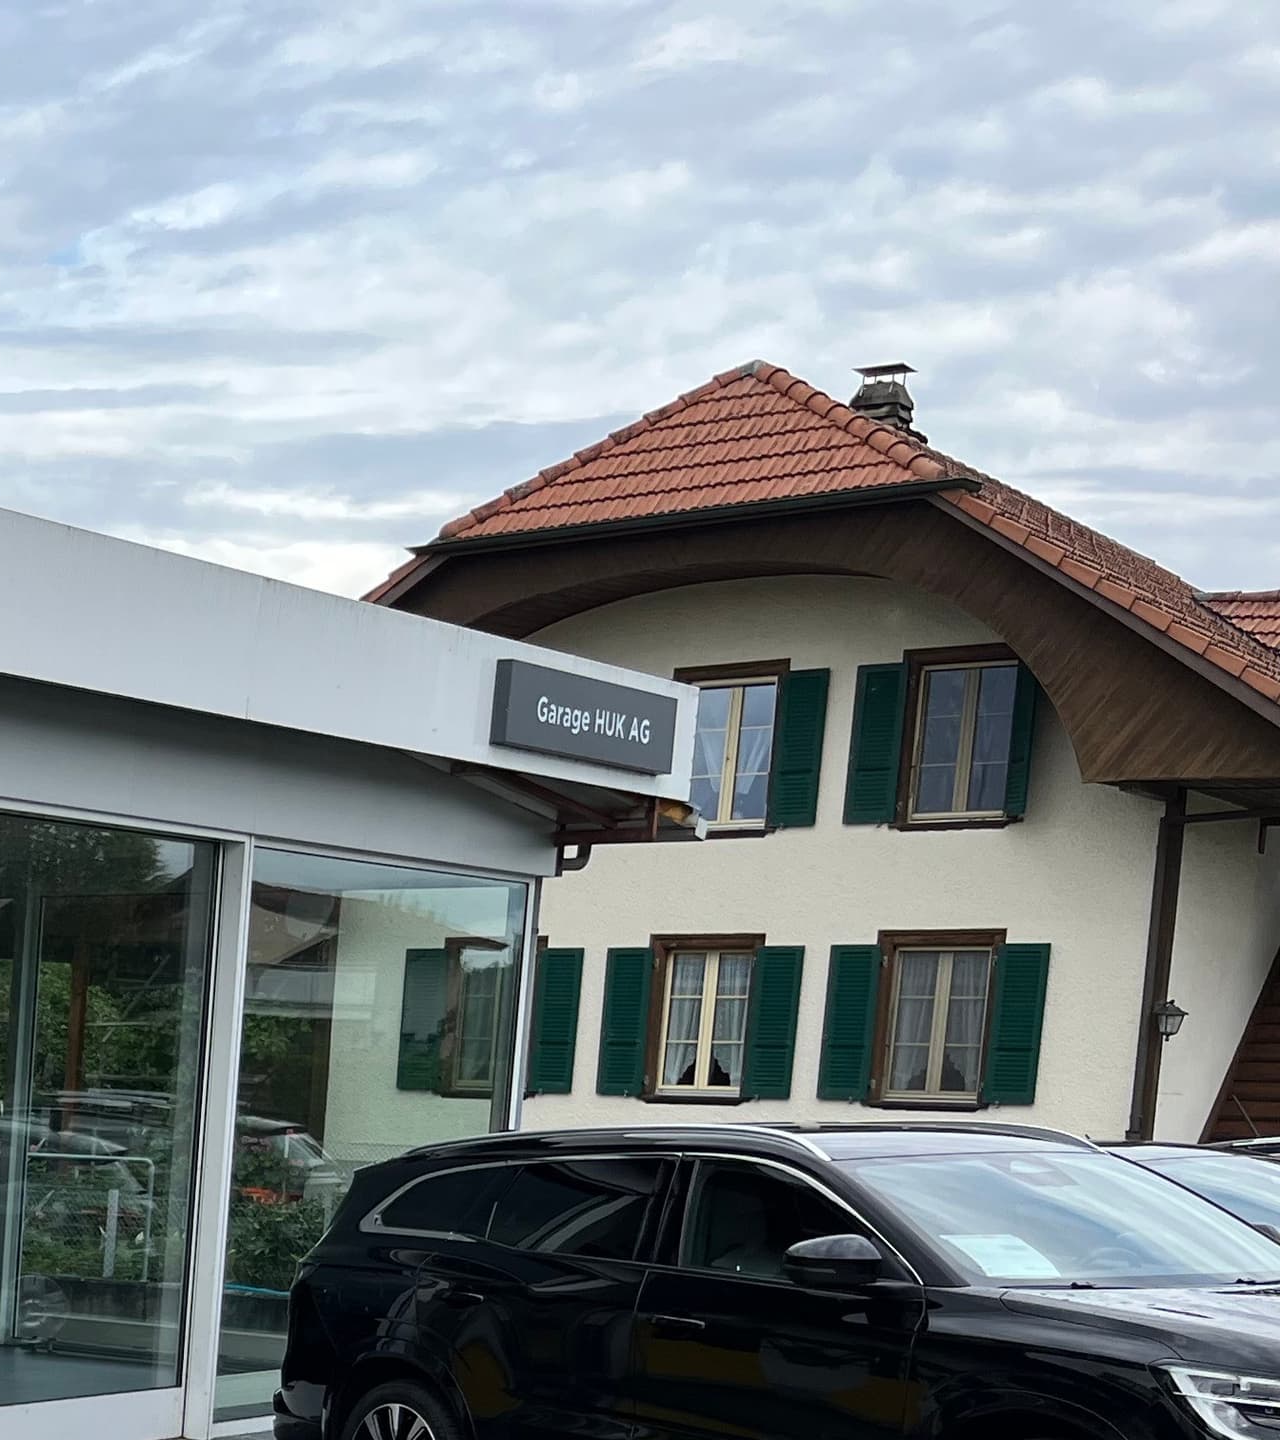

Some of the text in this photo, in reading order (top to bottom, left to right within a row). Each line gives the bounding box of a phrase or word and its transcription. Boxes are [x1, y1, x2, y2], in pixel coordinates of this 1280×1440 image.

[536, 696, 651, 744] Garage HUK AG
